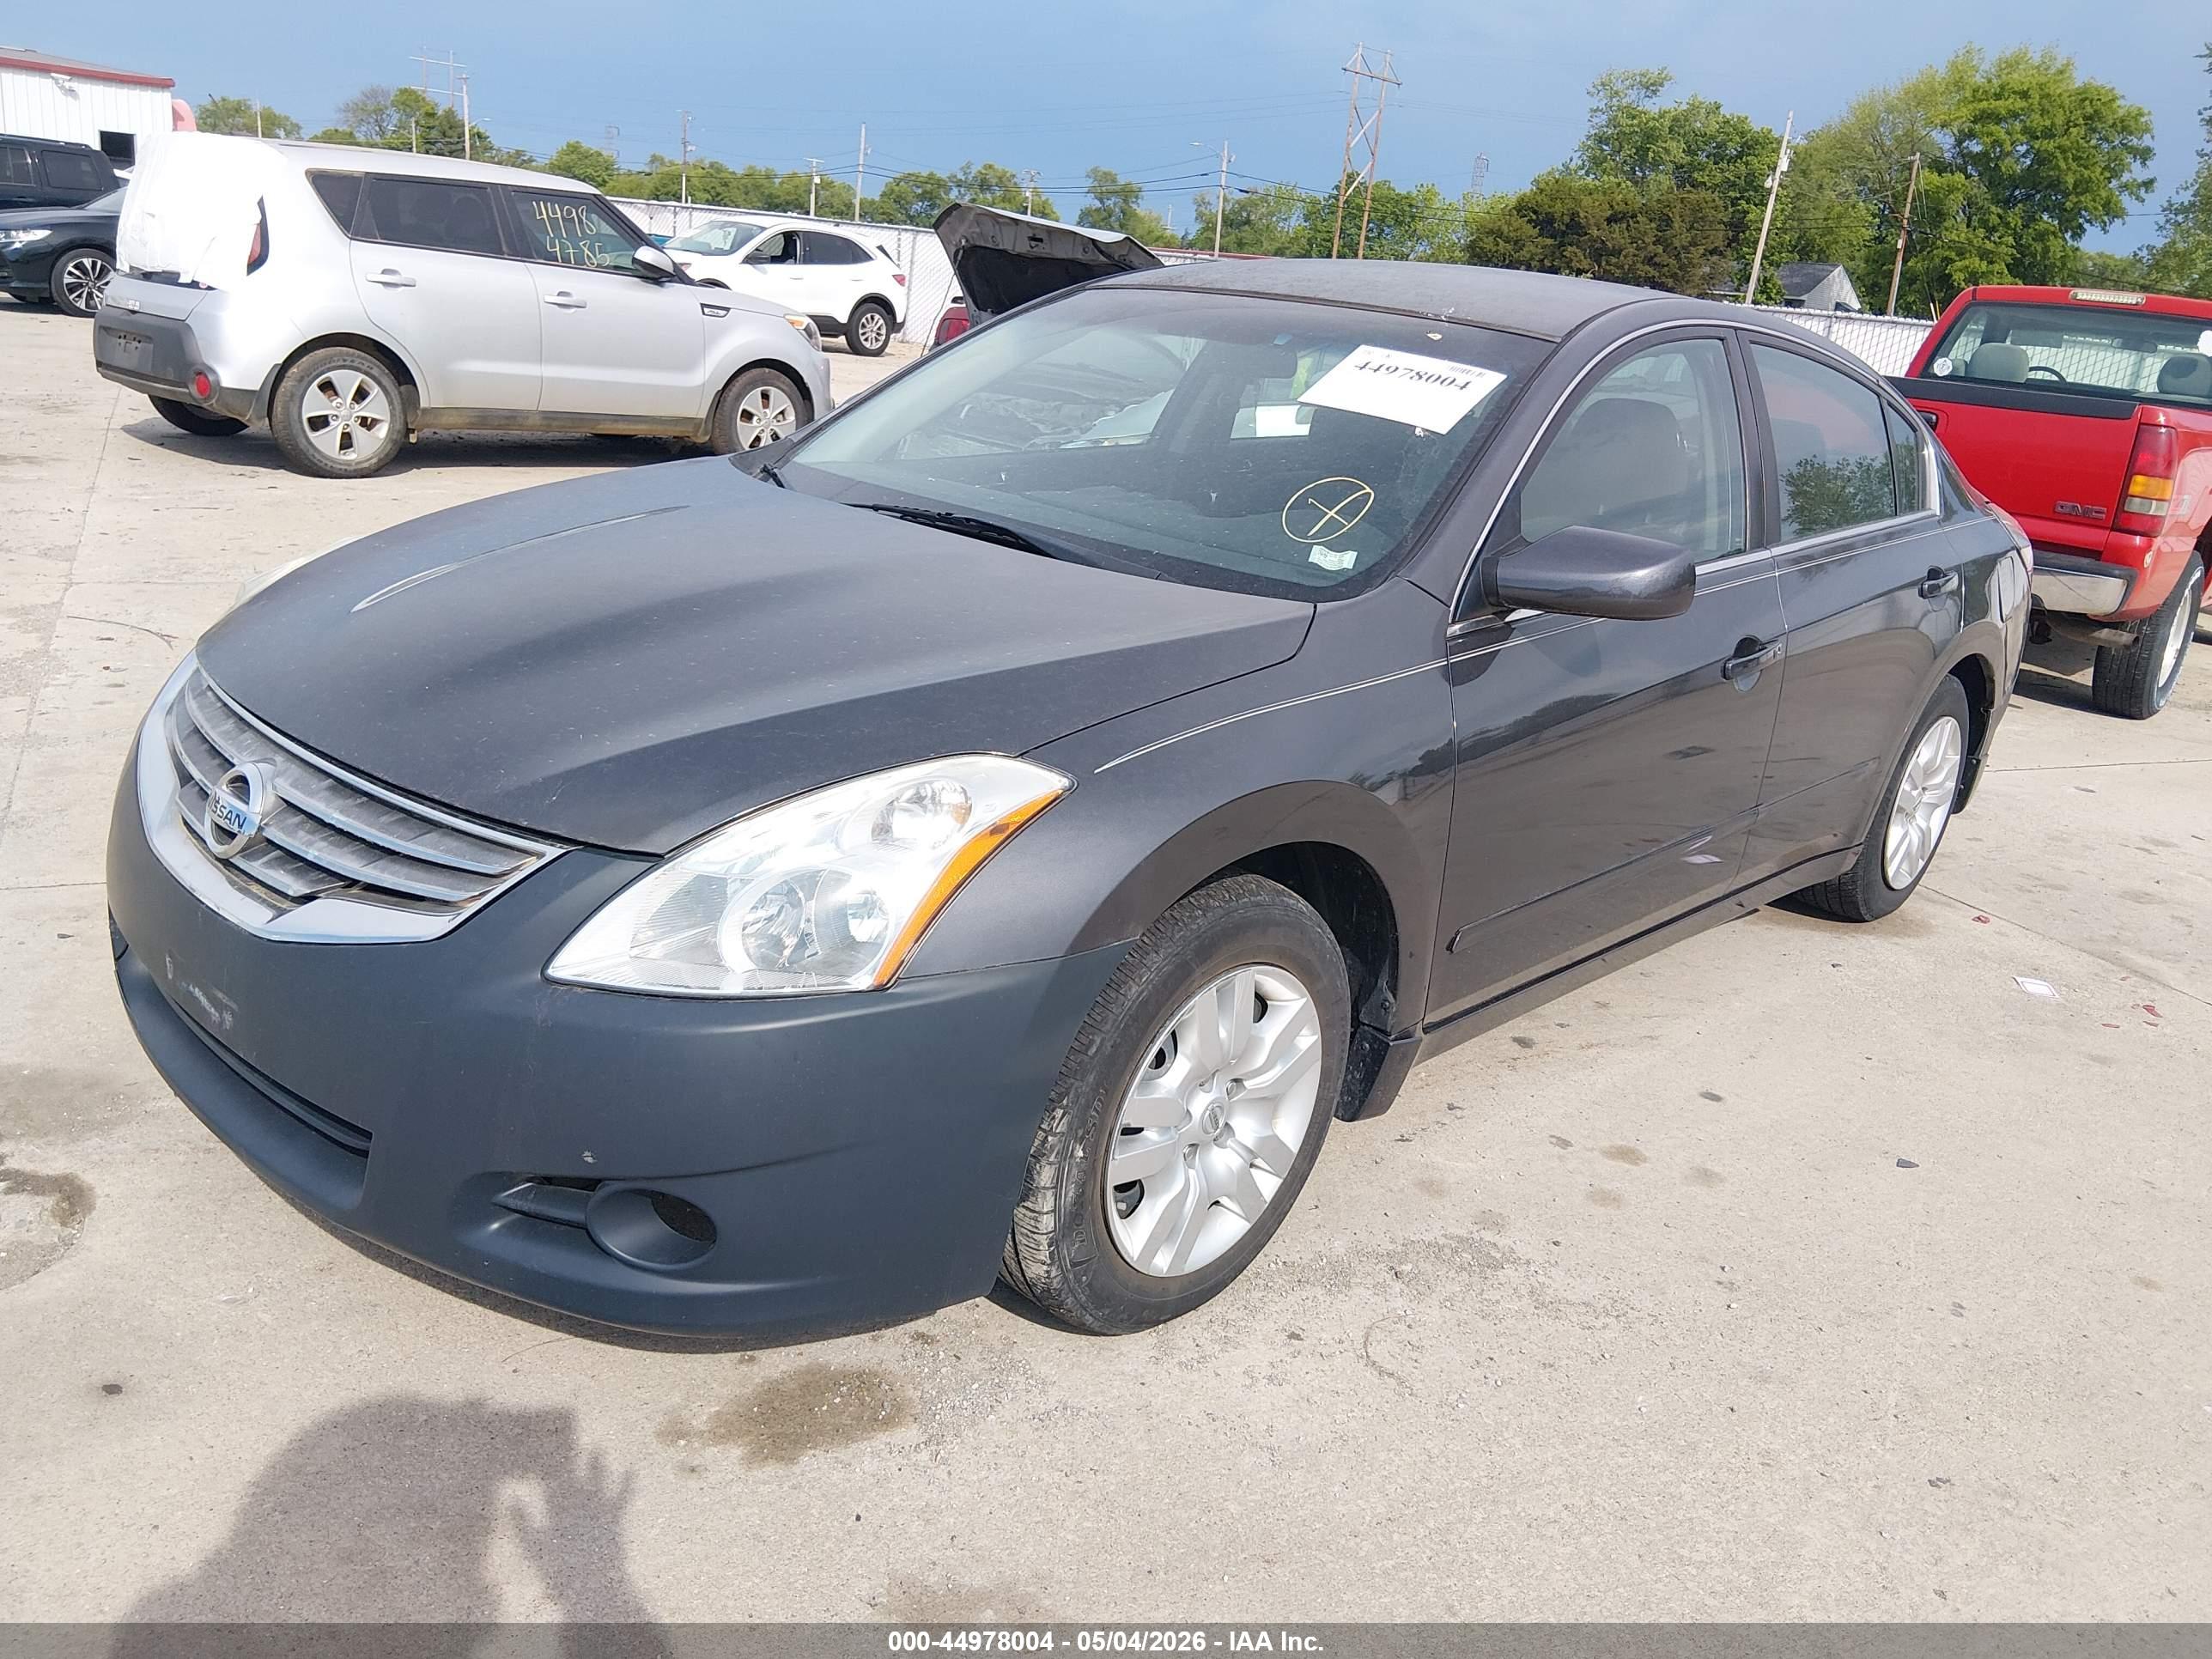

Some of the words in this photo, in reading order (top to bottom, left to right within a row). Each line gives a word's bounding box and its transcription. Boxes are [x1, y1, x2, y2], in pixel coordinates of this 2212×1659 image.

[532, 201, 597, 238] 4498
[546, 235, 611, 268] 4785
[1353, 361, 1473, 391] 44978004
[2055, 501, 2107, 520] GMC
